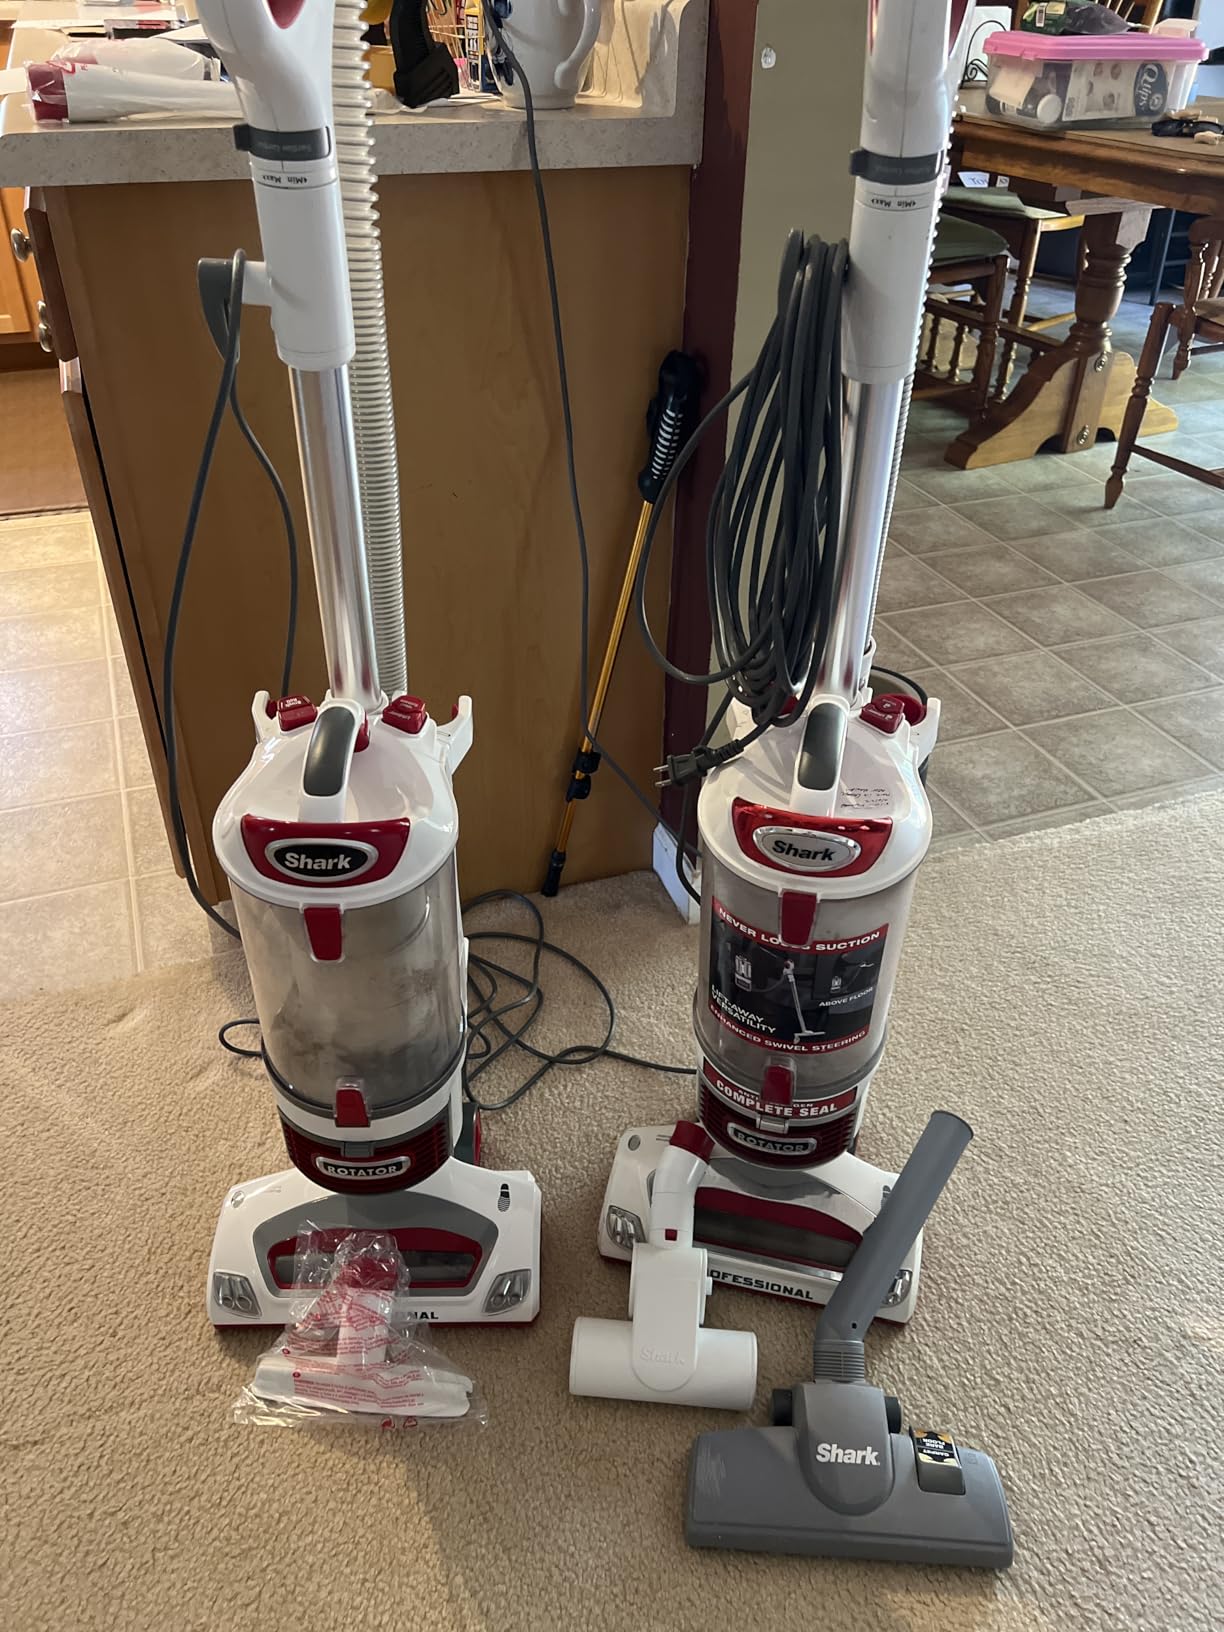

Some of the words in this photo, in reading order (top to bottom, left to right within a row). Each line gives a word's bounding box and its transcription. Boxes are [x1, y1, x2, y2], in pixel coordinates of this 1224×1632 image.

[284, 851, 352, 870] Shark
[771, 839, 837, 861] Shark
[719, 907, 757, 938] NEVER
[815, 931, 880, 951] SUCTION
[711, 984, 764, 1023] LIFT-AWAY
[819, 998, 848, 1007] ABOVE
[849, 986, 874, 1001] FLOOR
[711, 990, 776, 1034] VERSATILITY
[710, 1004, 761, 1043] ENHANCED
[764, 1040, 808, 1052] SWIVEL
[812, 1030, 866, 1051] STEERING
[716, 1079, 793, 1116] COMPLETE
[799, 1103, 838, 1117] SEAL
[736, 1131, 805, 1152] ROTATOR
[327, 1165, 398, 1177] ROTATOR
[709, 1269, 813, 1300] OFESSIONAL
[815, 1442, 879, 1466] Shark
